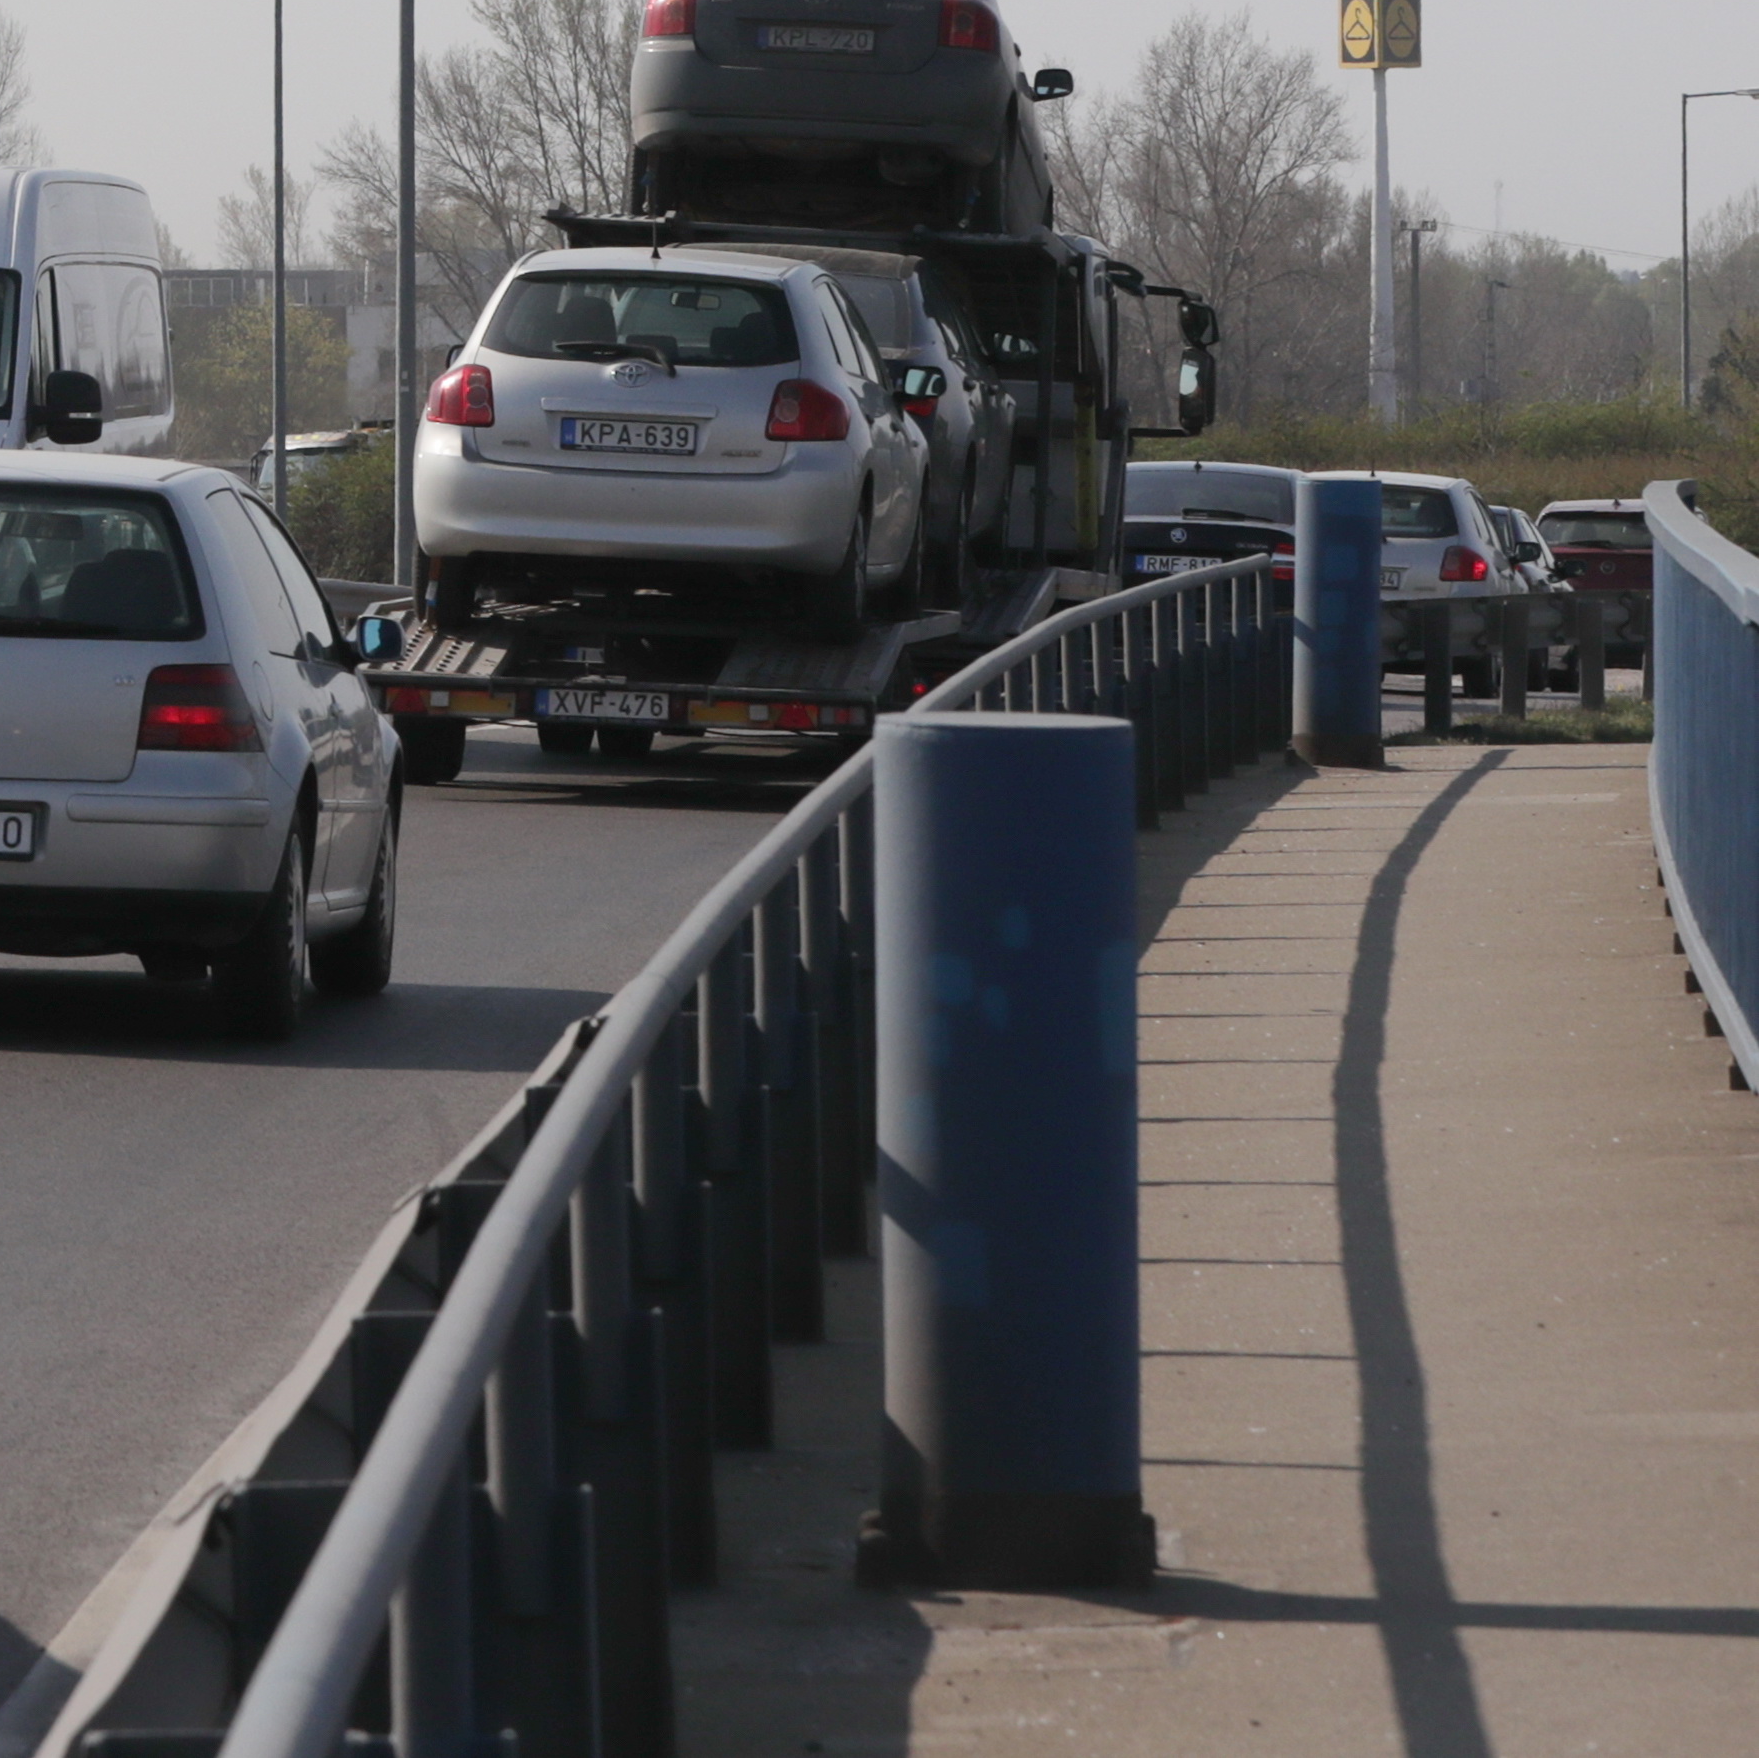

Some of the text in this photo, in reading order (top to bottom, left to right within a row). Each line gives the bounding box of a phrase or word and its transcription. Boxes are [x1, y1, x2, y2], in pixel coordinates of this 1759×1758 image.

[772, 28, 869, 49] KPL-720
[580, 423, 690, 448] KPA-639
[554, 692, 664, 717] XVF-476
